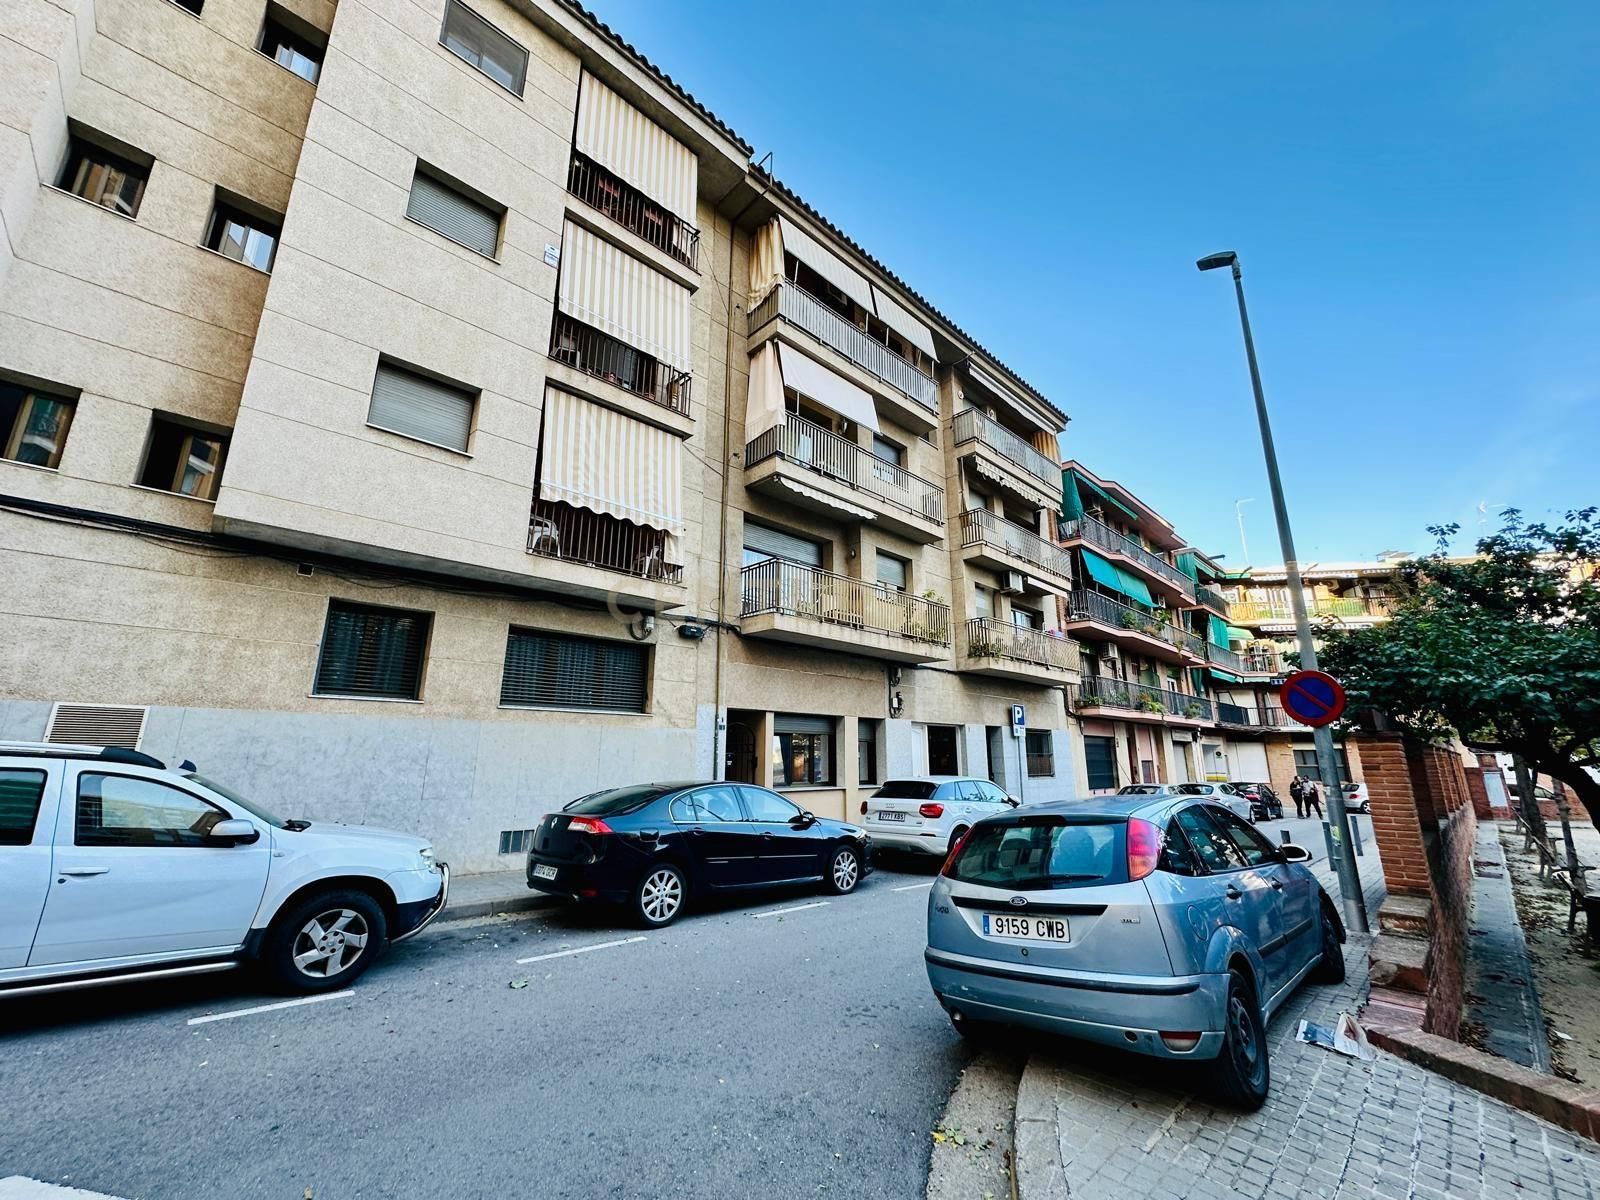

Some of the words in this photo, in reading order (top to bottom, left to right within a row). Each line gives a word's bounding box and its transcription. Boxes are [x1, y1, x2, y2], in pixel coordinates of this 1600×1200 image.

[1014, 706, 1023, 724] P
[995, 917, 1029, 935] 9159
[1036, 920, 1065, 938] CWB
